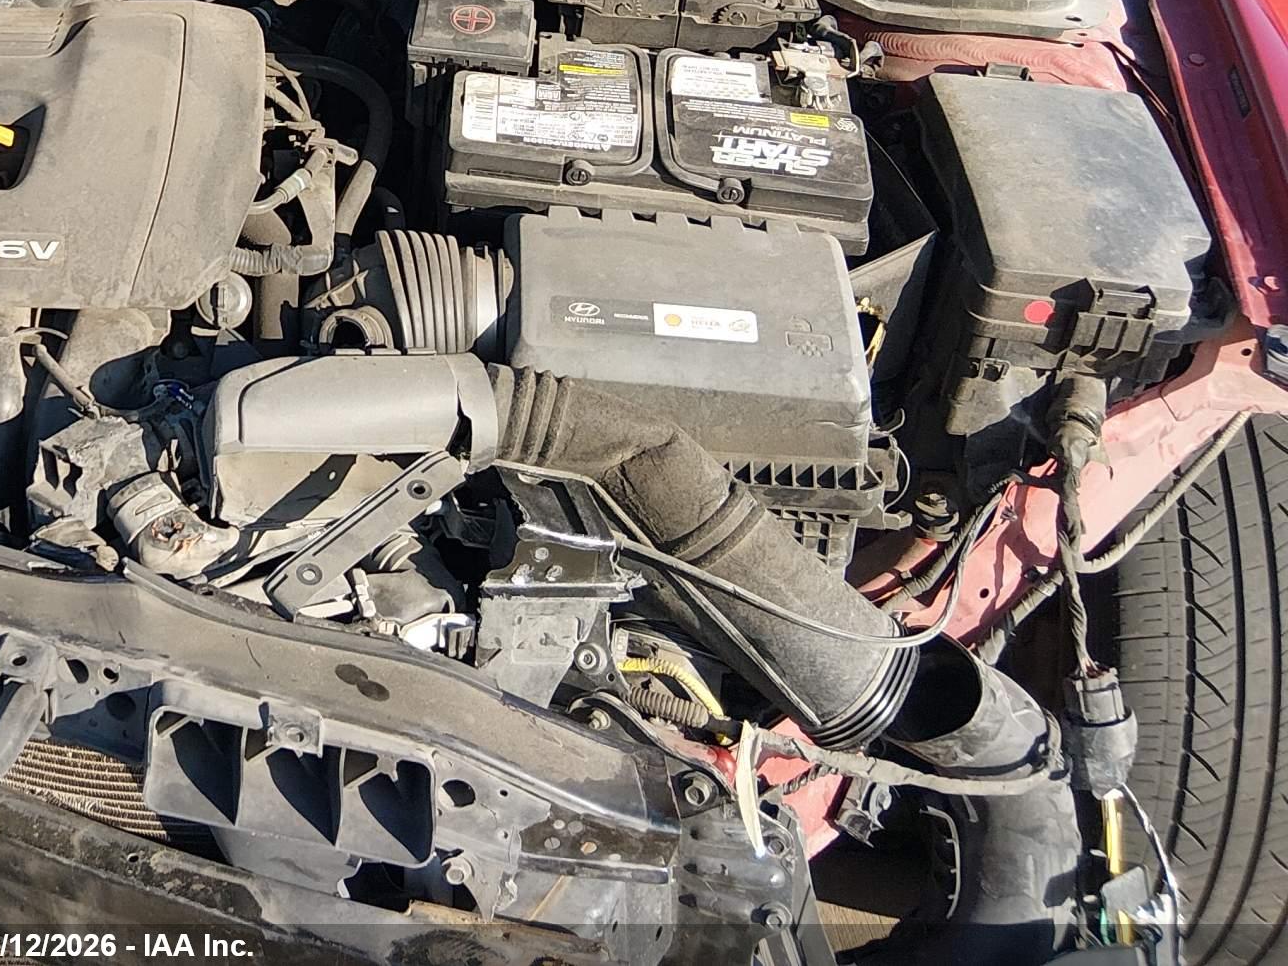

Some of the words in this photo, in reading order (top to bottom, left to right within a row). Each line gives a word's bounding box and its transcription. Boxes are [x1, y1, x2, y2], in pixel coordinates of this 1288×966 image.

[732, 125, 827, 146] PLATINUM
[710, 136, 833, 167] START
[712, 150, 818, 176] SUPER
[564, 316, 605, 325] HYUNDAI
